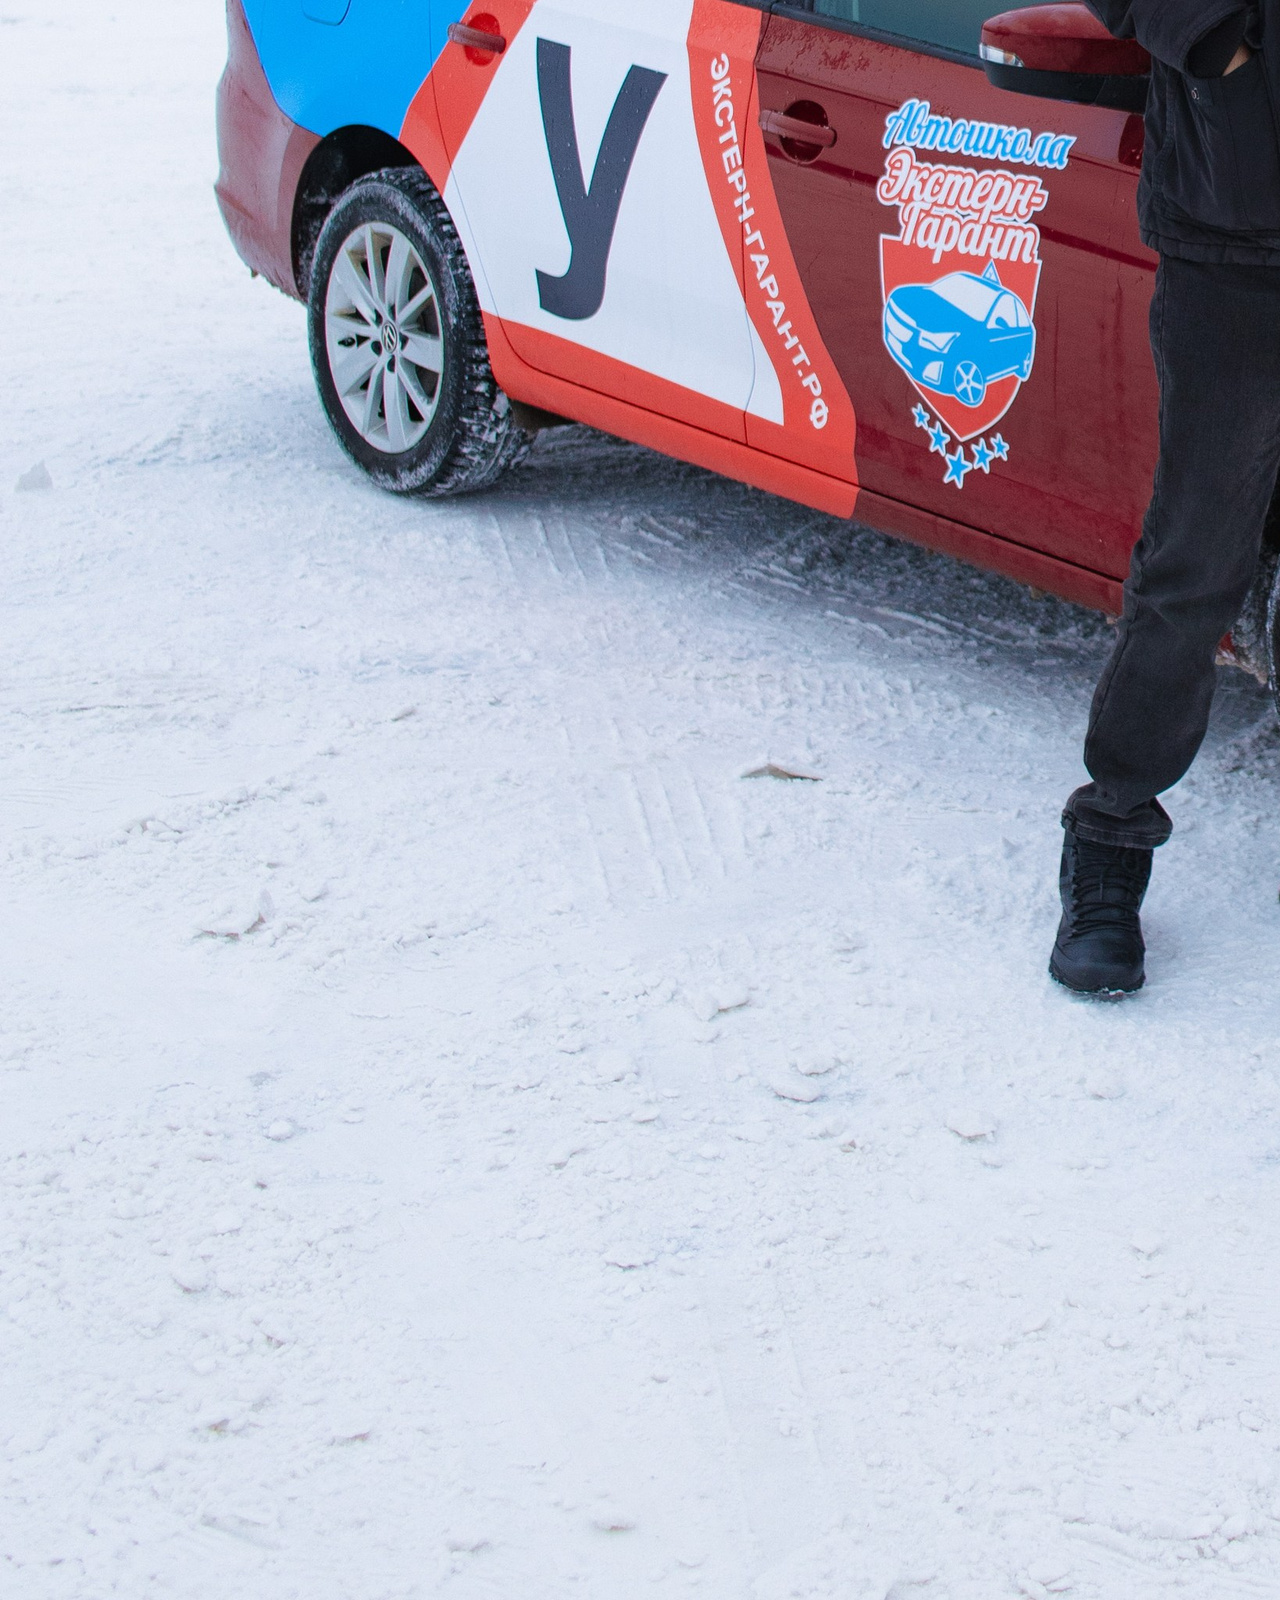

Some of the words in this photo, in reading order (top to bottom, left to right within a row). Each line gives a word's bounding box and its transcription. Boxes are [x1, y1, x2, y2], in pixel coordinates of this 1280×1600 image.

[884, 100, 1075, 169] Автошкола
[879, 150, 1047, 221] Экстерн-
[710, 52, 830, 430] ЭКСТЕРН-ГАРАНТ.РФ
[901, 201, 1038, 264] Гарант
